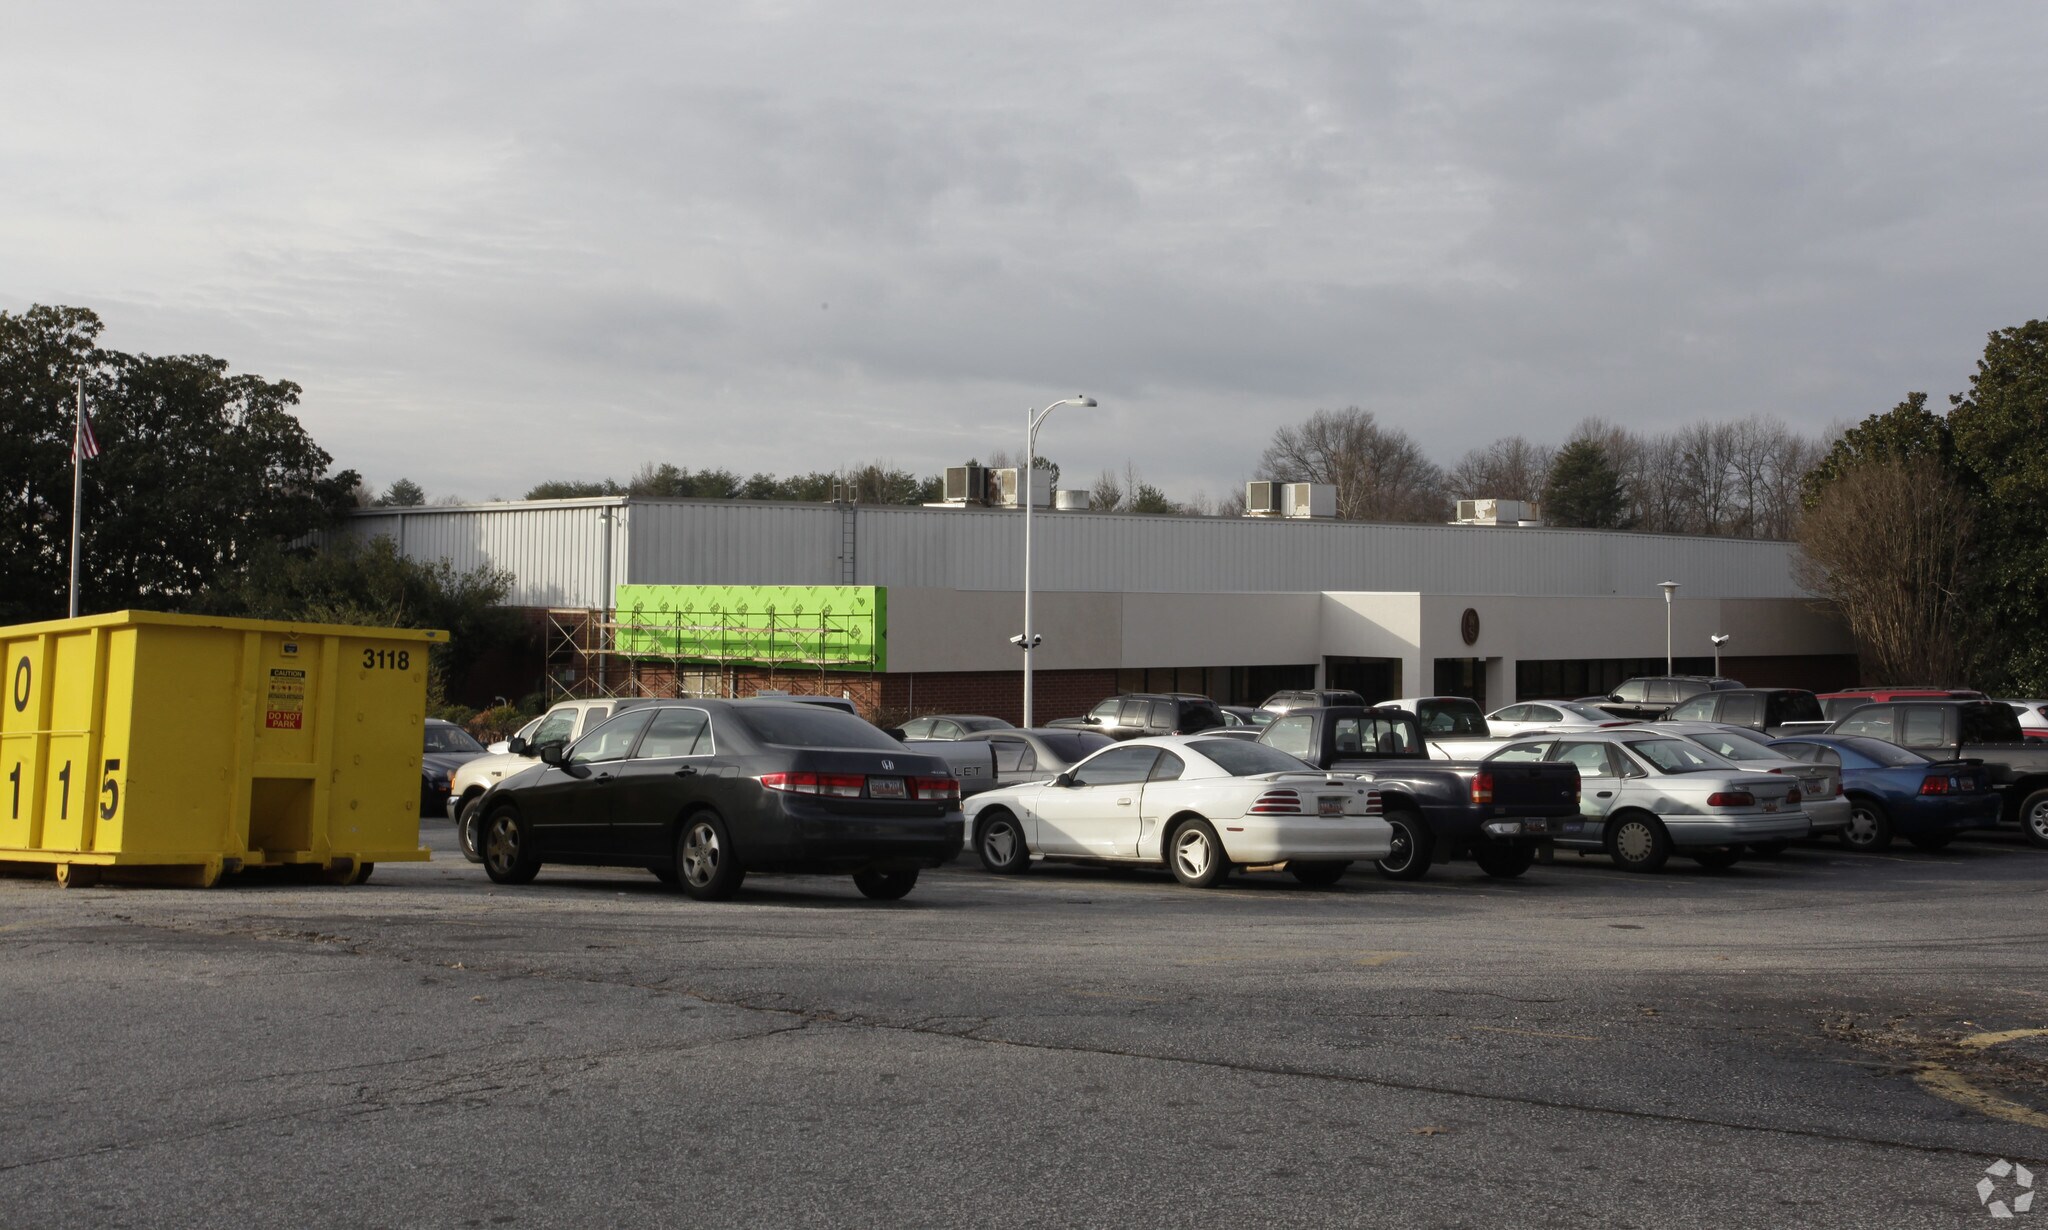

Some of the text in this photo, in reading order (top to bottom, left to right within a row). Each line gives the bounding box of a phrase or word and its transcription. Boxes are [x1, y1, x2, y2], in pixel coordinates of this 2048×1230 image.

[363, 648, 410, 671] 3118
[274, 669, 303, 678] CAUTION
[268, 712, 301, 721] DO NOT
[272, 720, 296, 729] PARK
